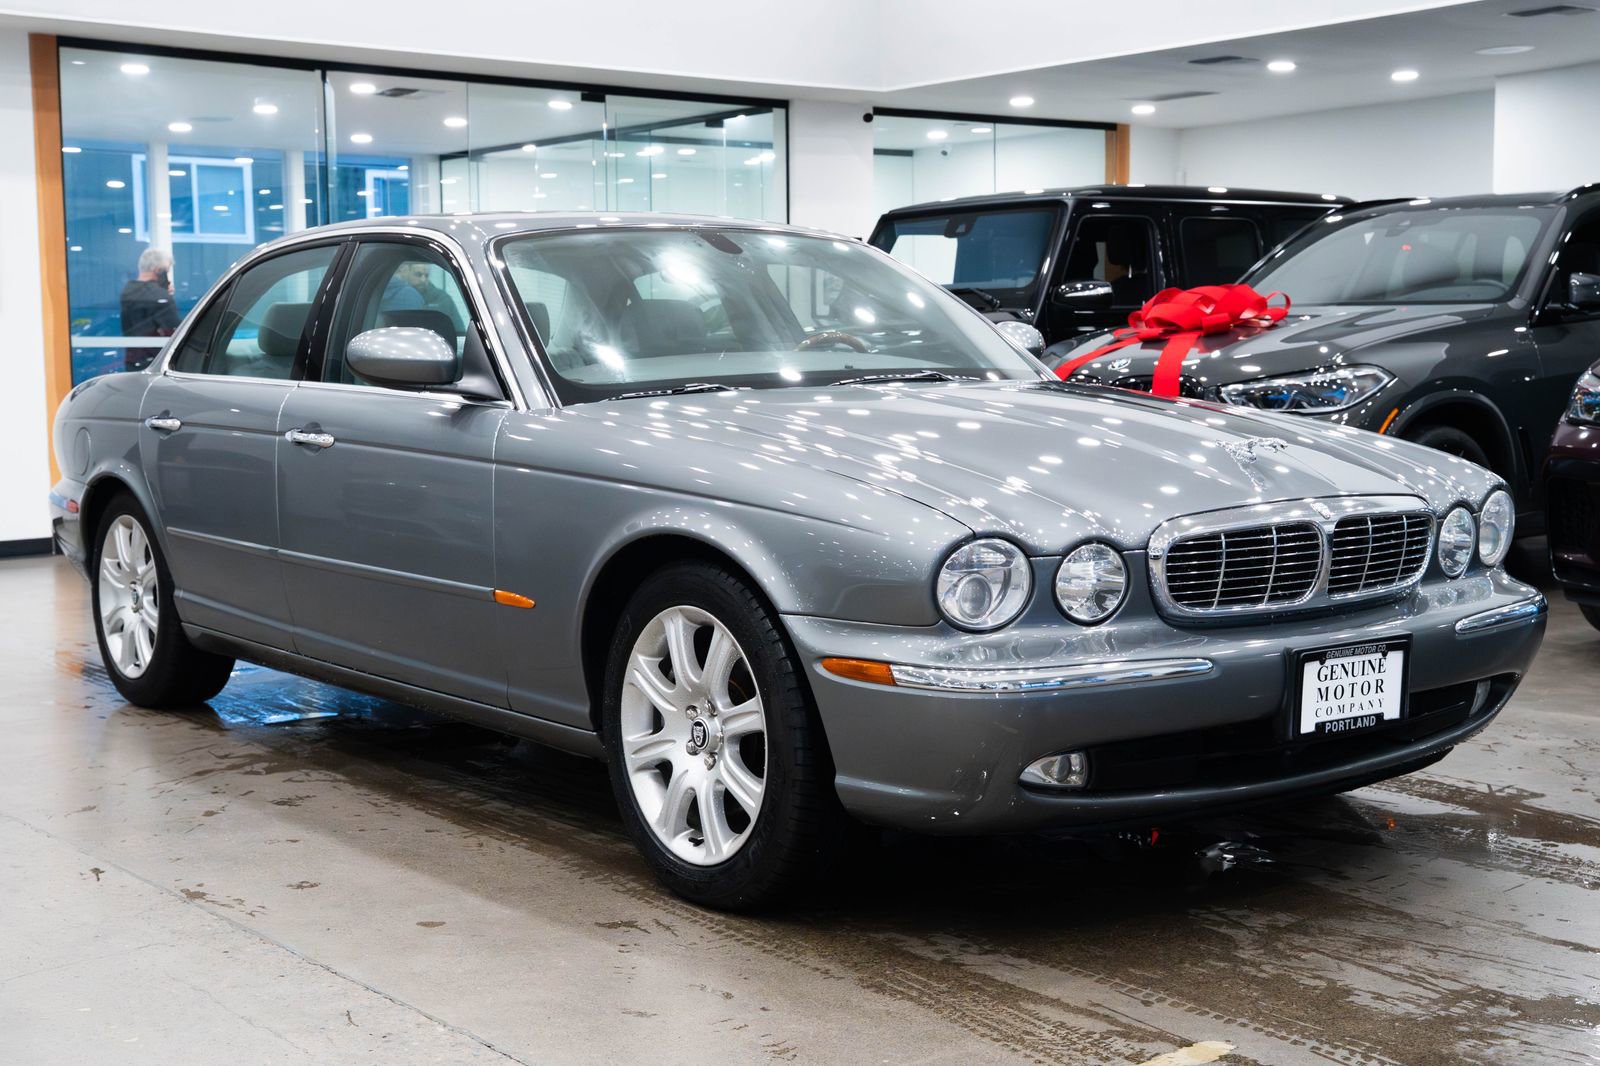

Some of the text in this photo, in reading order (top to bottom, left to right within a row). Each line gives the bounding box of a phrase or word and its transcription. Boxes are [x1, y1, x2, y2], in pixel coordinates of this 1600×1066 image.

[1326, 648, 1354, 659] GENUINE
[1354, 645, 1377, 656] MOTOR
[1317, 657, 1387, 682] GENUINE
[1316, 678, 1385, 703] MOTOR
[1315, 698, 1385, 718] COMPANY
[1325, 715, 1377, 733] PORTLAND
